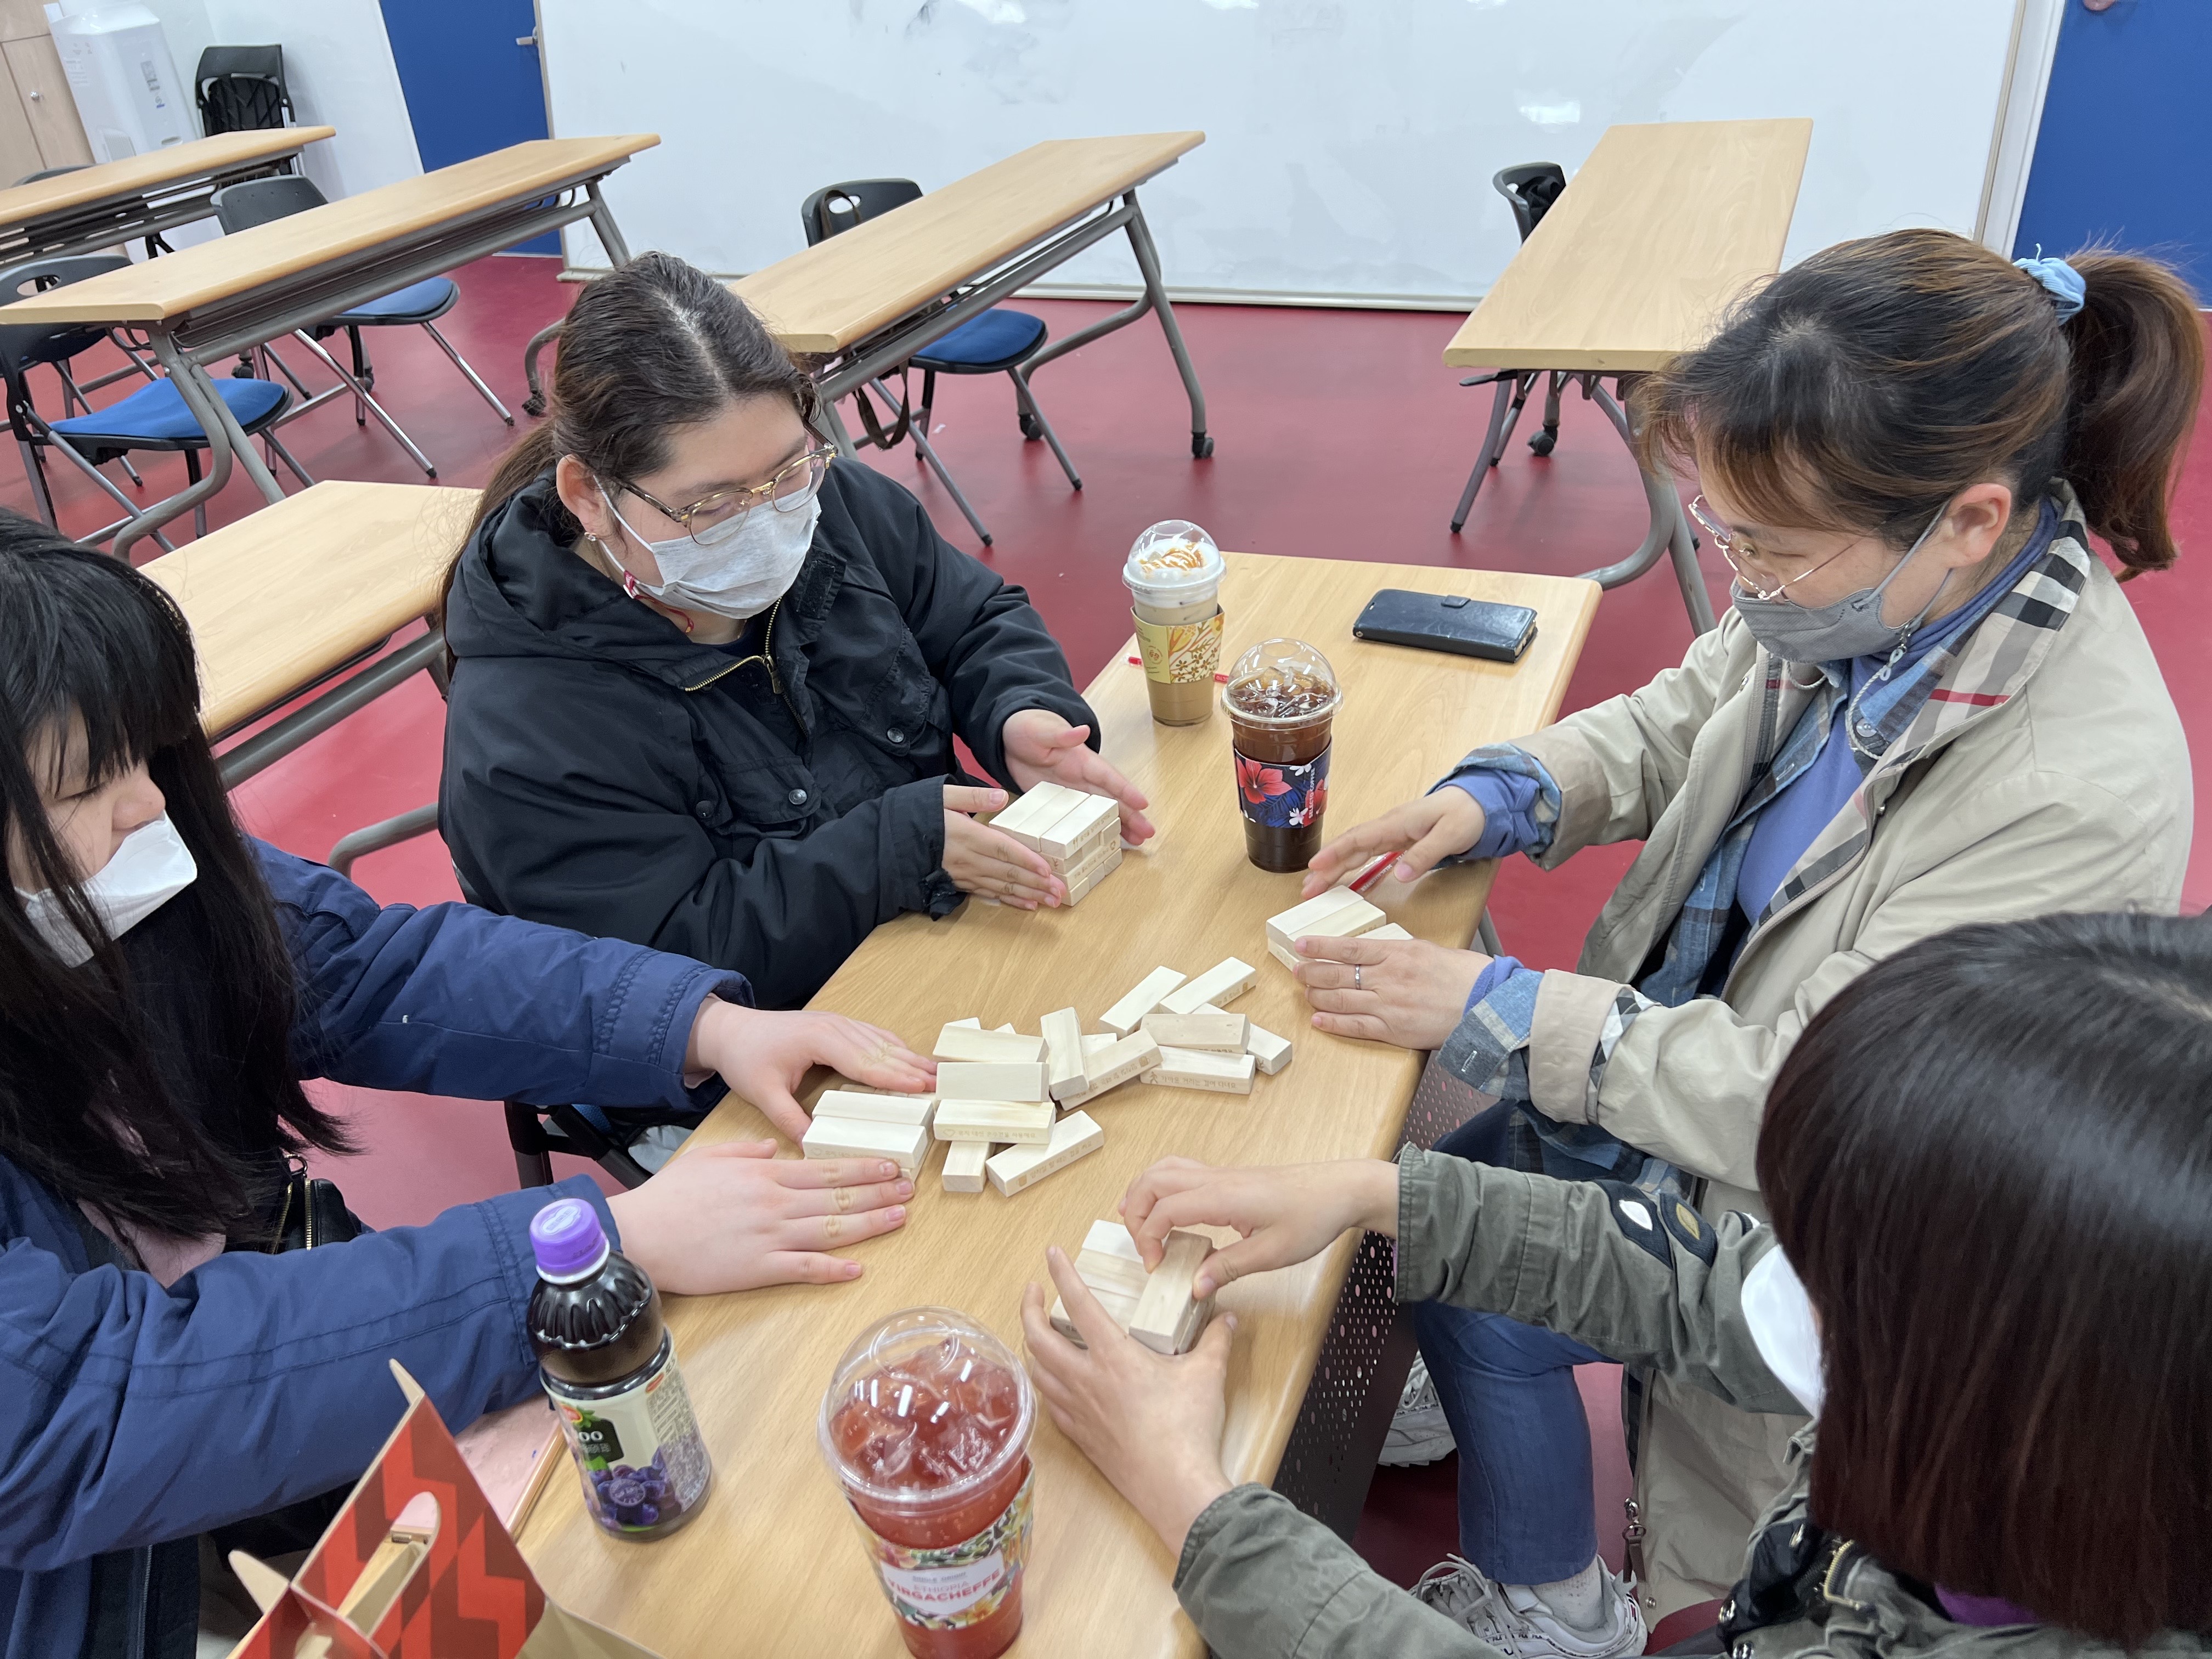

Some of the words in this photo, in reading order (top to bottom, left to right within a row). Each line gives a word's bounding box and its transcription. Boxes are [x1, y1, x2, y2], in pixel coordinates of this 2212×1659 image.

[1160, 1075, 1180, 1084] 가까운
[1182, 1077, 1201, 1086] 거리는
[886, 1568, 1001, 1601] YIRGACHEFFE
[913, 1581, 970, 1593] ETHIOPIA
